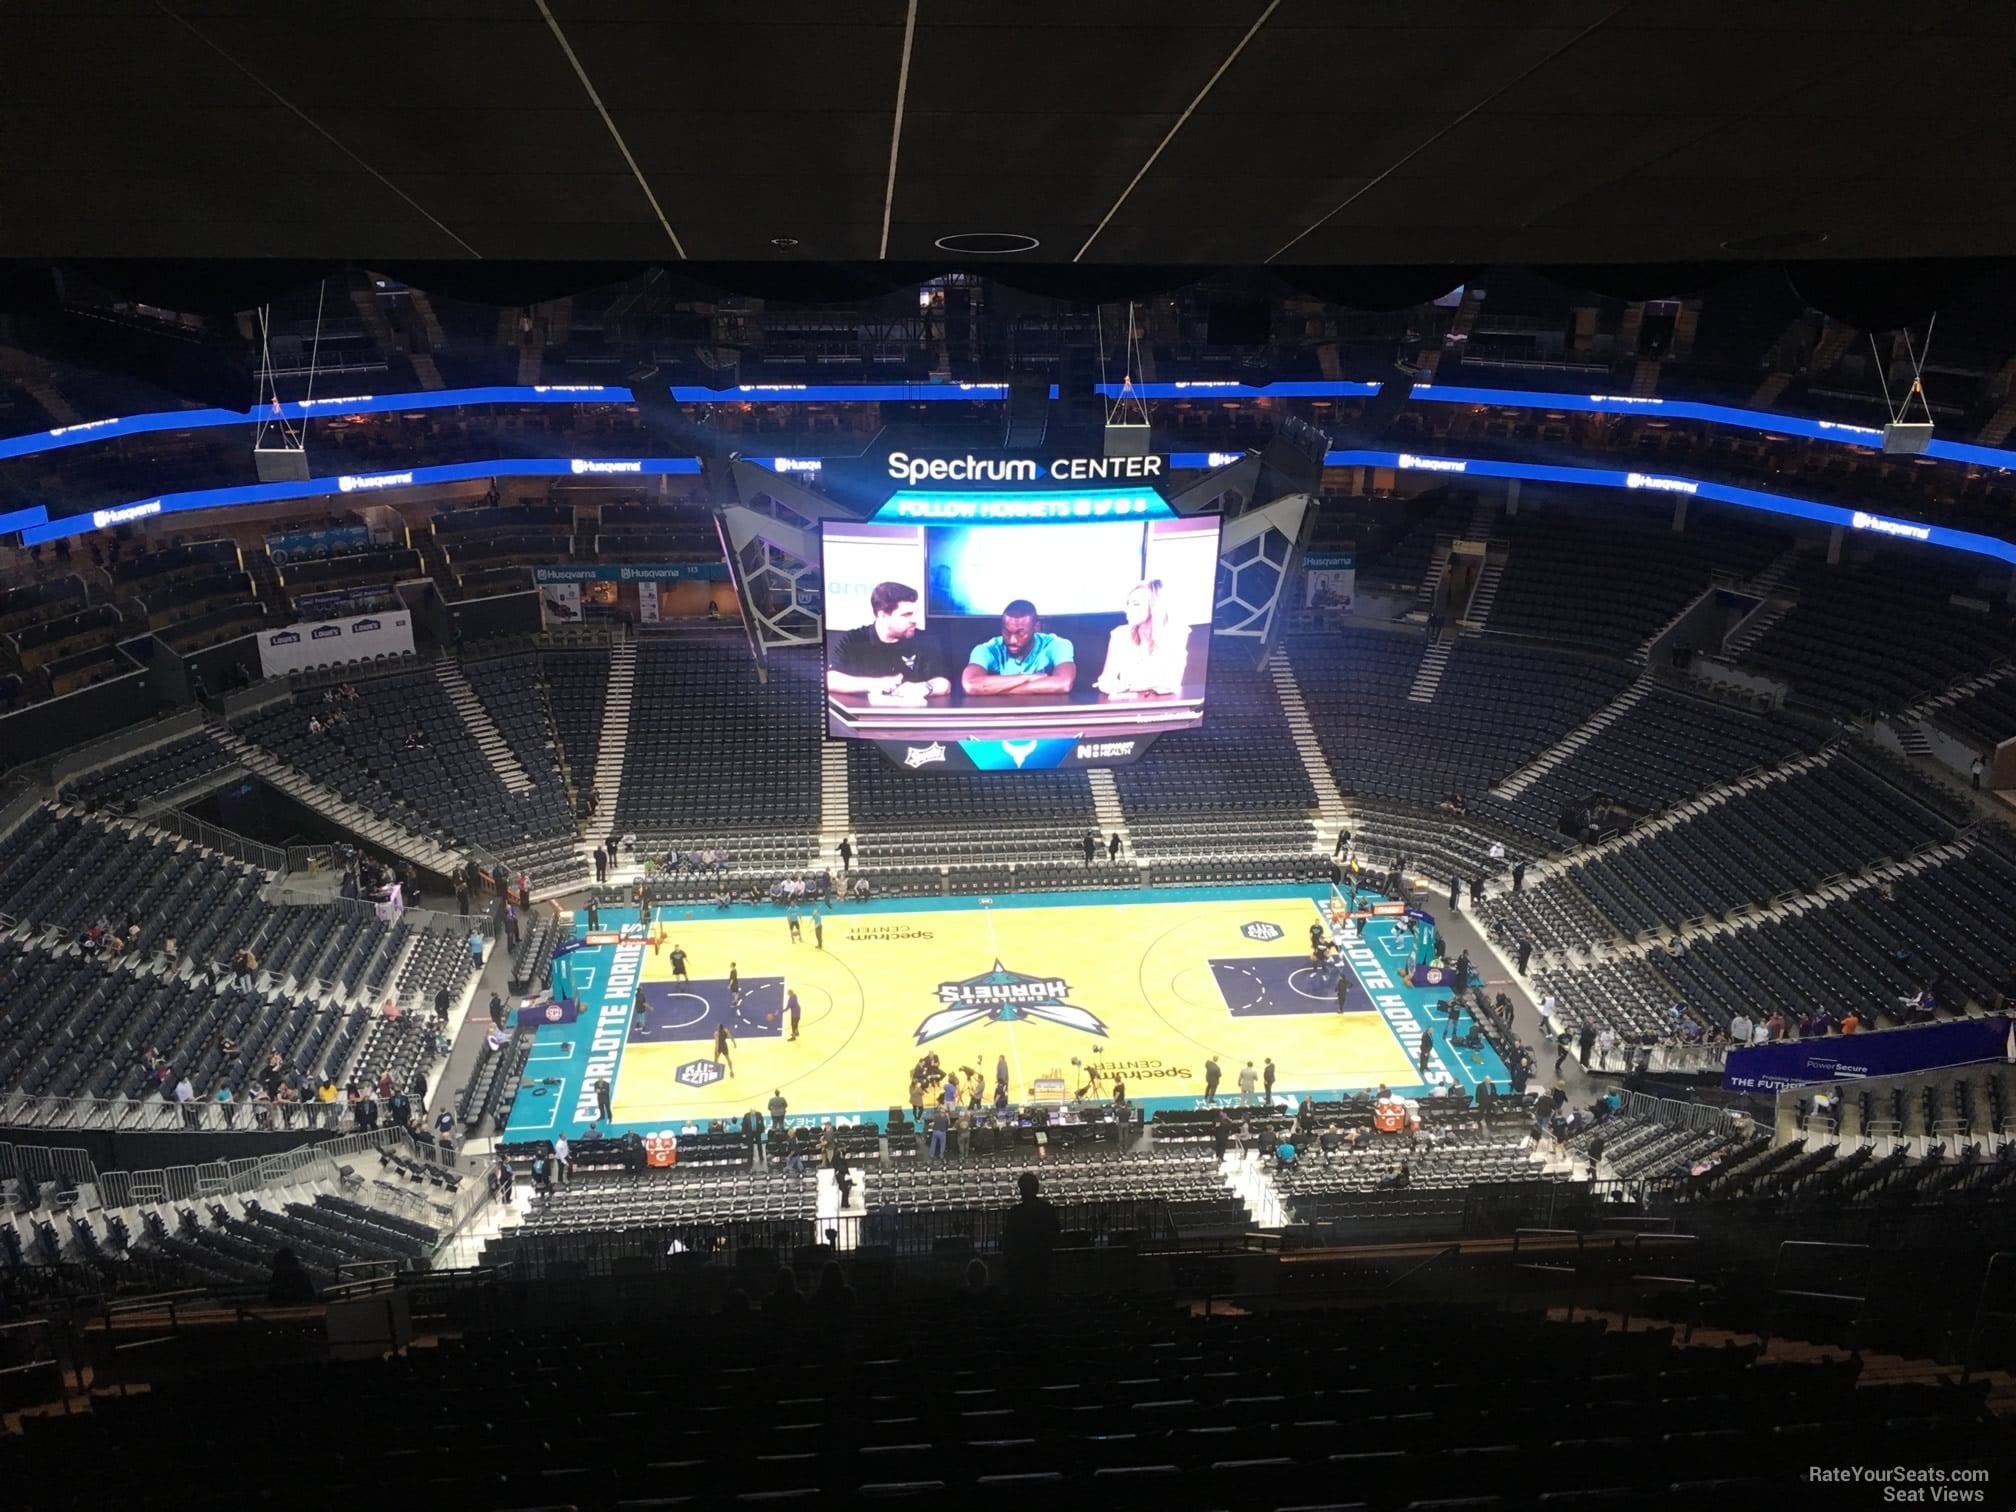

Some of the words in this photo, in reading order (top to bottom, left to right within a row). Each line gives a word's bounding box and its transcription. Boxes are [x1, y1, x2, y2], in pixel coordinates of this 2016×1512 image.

[583, 460, 642, 473] Husqvarna
[888, 451, 1035, 485] Spectrum
[1051, 455, 1161, 479] CENTER
[1409, 456, 1467, 471] Husqvarna
[351, 472, 412, 489] Husqvarna
[1638, 475, 1698, 493] Husqvarna
[106, 501, 161, 524] Husqvarna
[898, 499, 977, 517] FOLLOW
[981, 499, 1070, 517] HORNETS
[1865, 515, 1931, 540] Husqvarna
[1306, 557, 1352, 567] Husqvarna
[547, 569, 597, 580] Husqvarna
[631, 568, 680, 579] Husqvarna
[850, 930, 935, 941] Spectrum
[939, 981, 1066, 1002] HORNETS
[1095, 1060, 1162, 1070] CENTER
[1807, 1060, 1868, 1073] PowerSecure
[1096, 1066, 1192, 1080] Spectrum
[1731, 1077, 1755, 1087] THE
